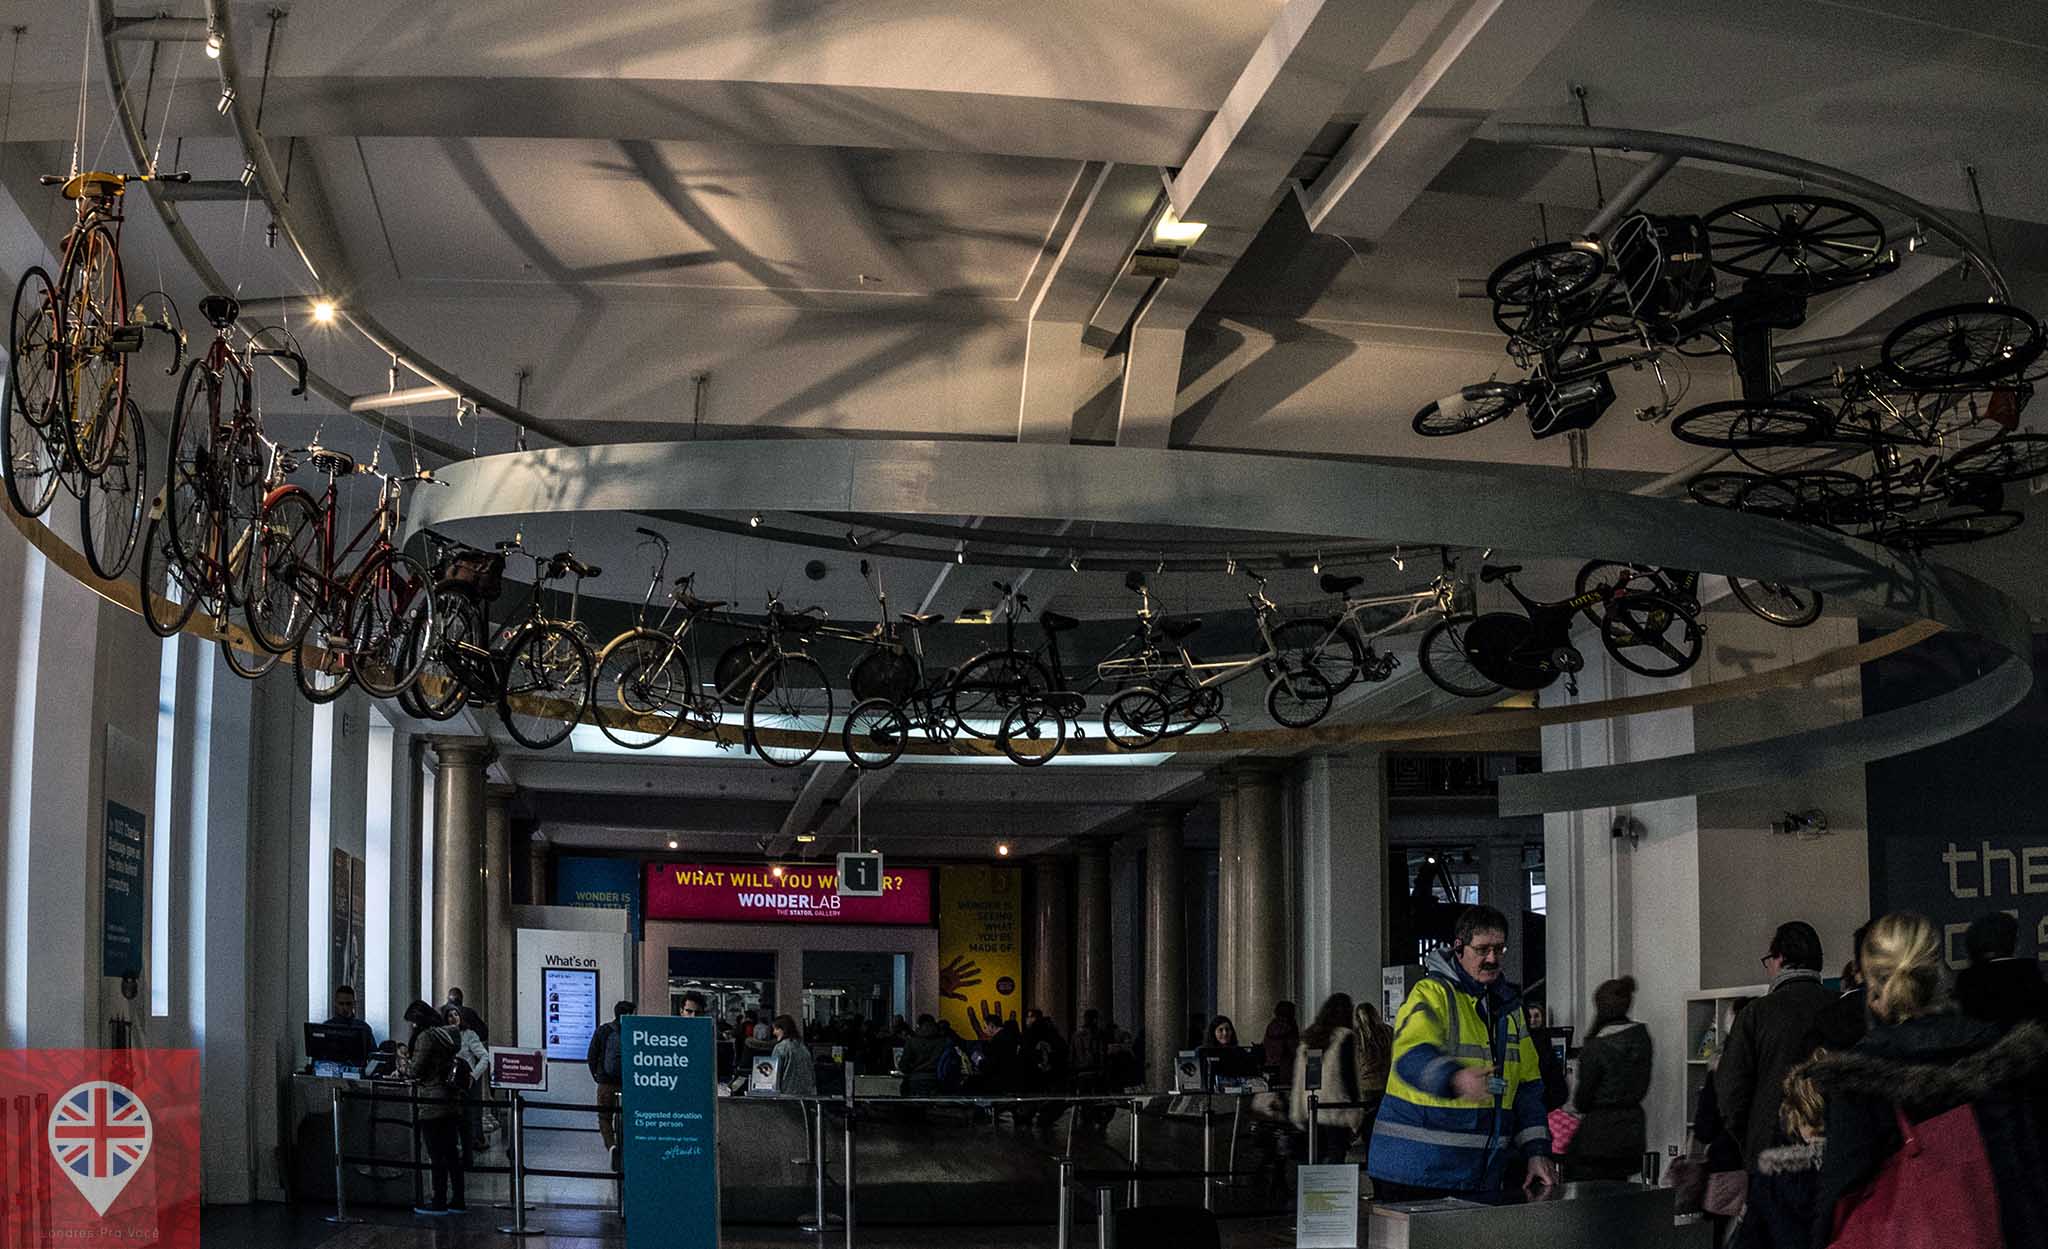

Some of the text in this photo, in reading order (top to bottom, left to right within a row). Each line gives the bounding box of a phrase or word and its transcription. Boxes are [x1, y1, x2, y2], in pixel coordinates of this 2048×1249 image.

[1942, 840, 2048, 898] the
[675, 870, 725, 886] WHAT
[730, 872, 773, 888] WILL
[780, 874, 812, 889] YOU
[575, 891, 632, 903] WONDER IS
[738, 893, 841, 910] WONDERLAB
[545, 954, 597, 968] What's on
[633, 1030, 688, 1047] Please
[633, 1050, 689, 1067] donate
[633, 1071, 678, 1091] today
[634, 1110, 703, 1119] Suggested donation
